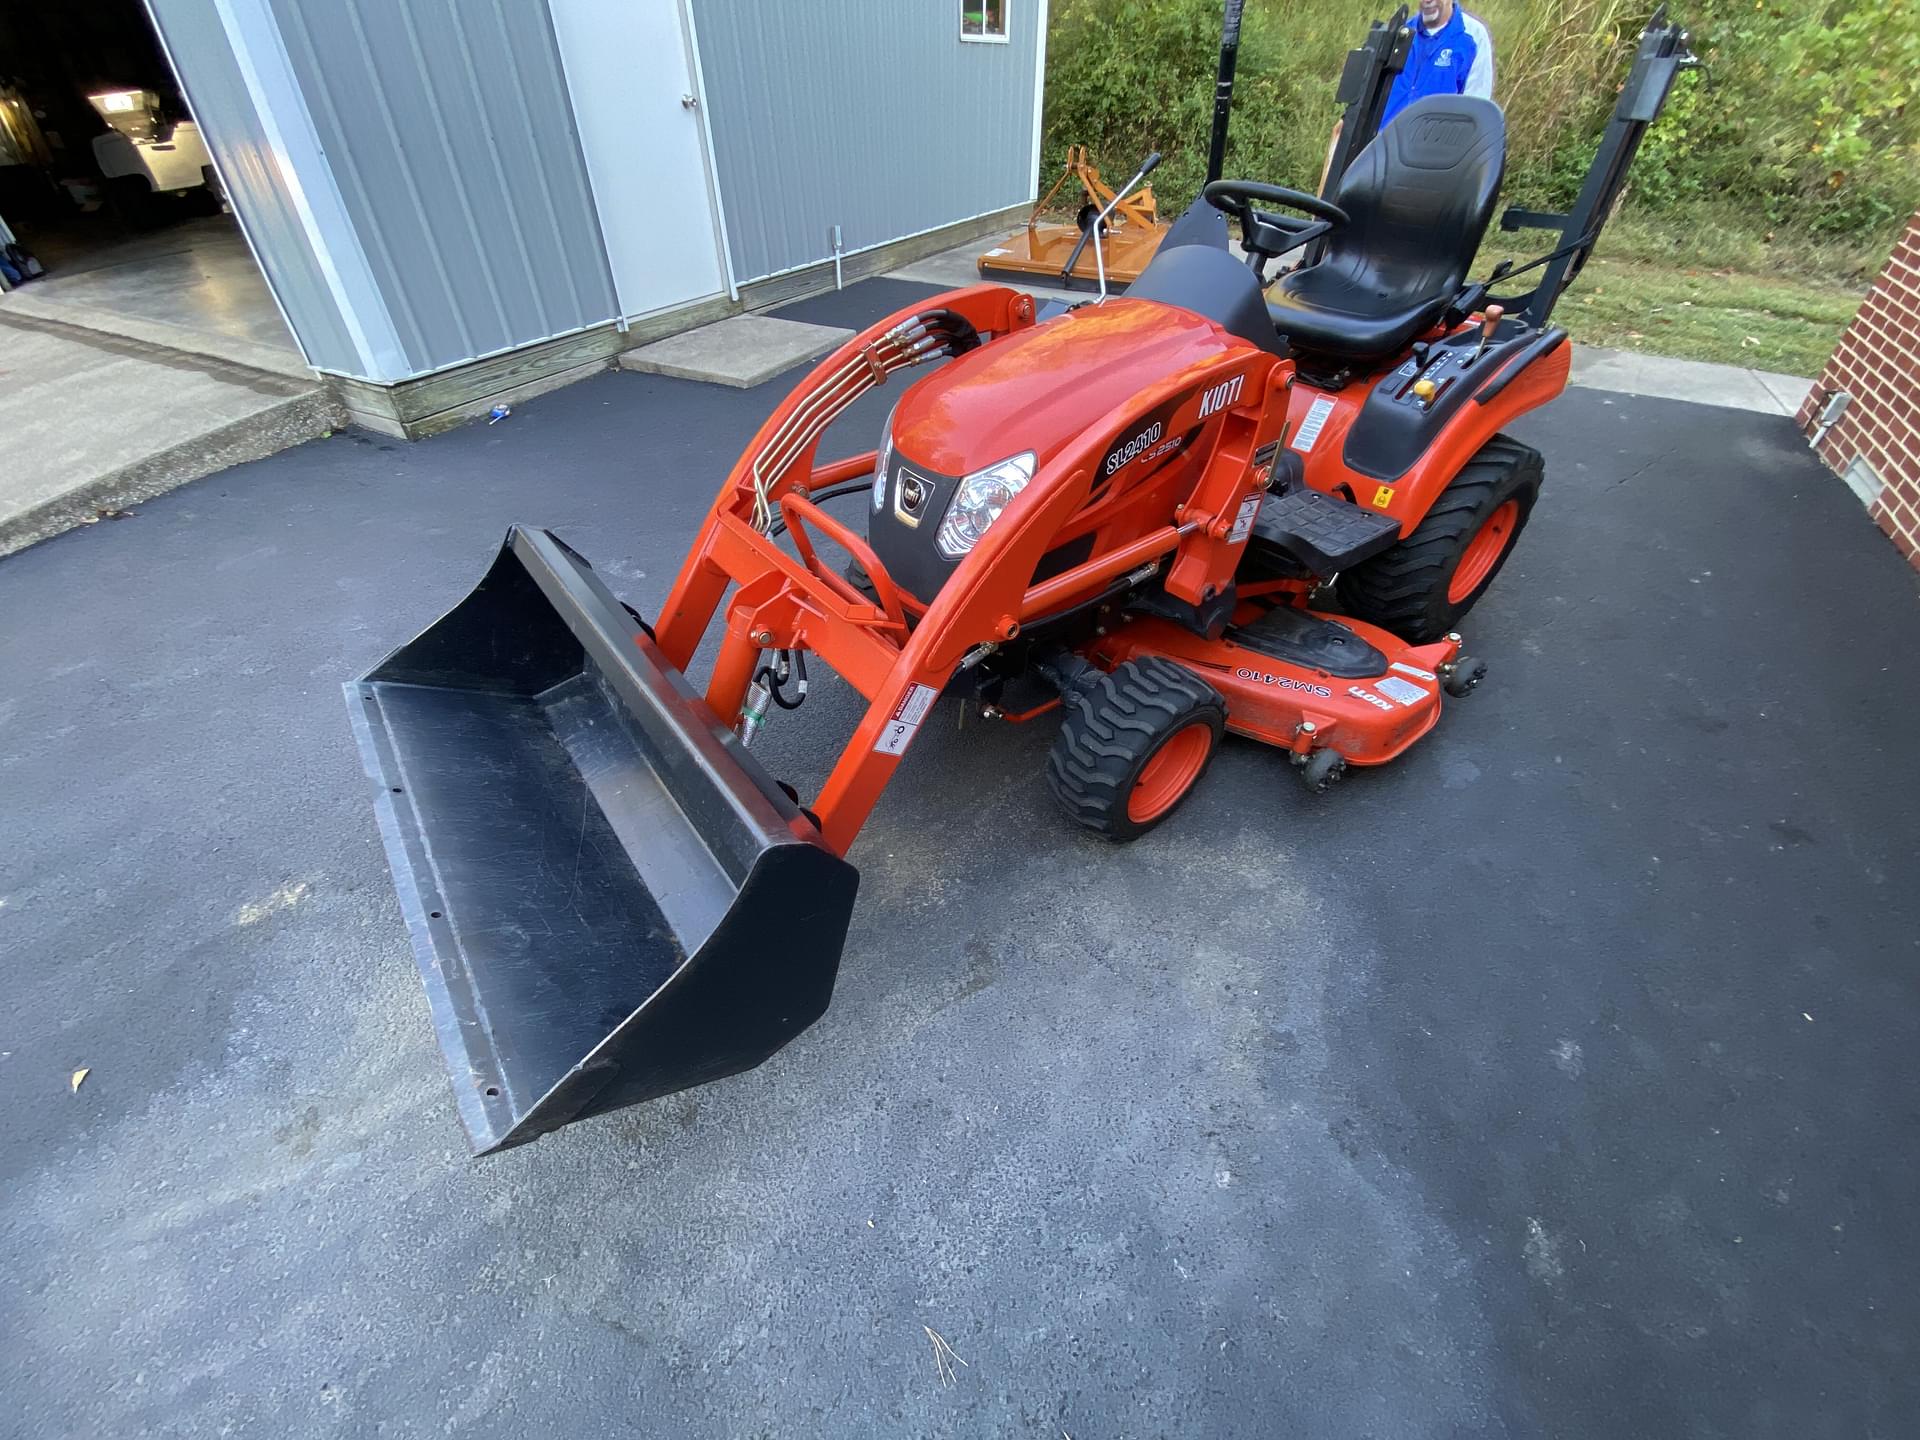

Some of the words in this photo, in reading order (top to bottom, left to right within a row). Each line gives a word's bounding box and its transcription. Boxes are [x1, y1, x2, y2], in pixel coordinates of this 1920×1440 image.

[1198, 374, 1245, 419] KIOTI
[1106, 421, 1162, 475] SL2410
[1235, 667, 1333, 699] SM2410
[1347, 685, 1394, 711] KIOTI
